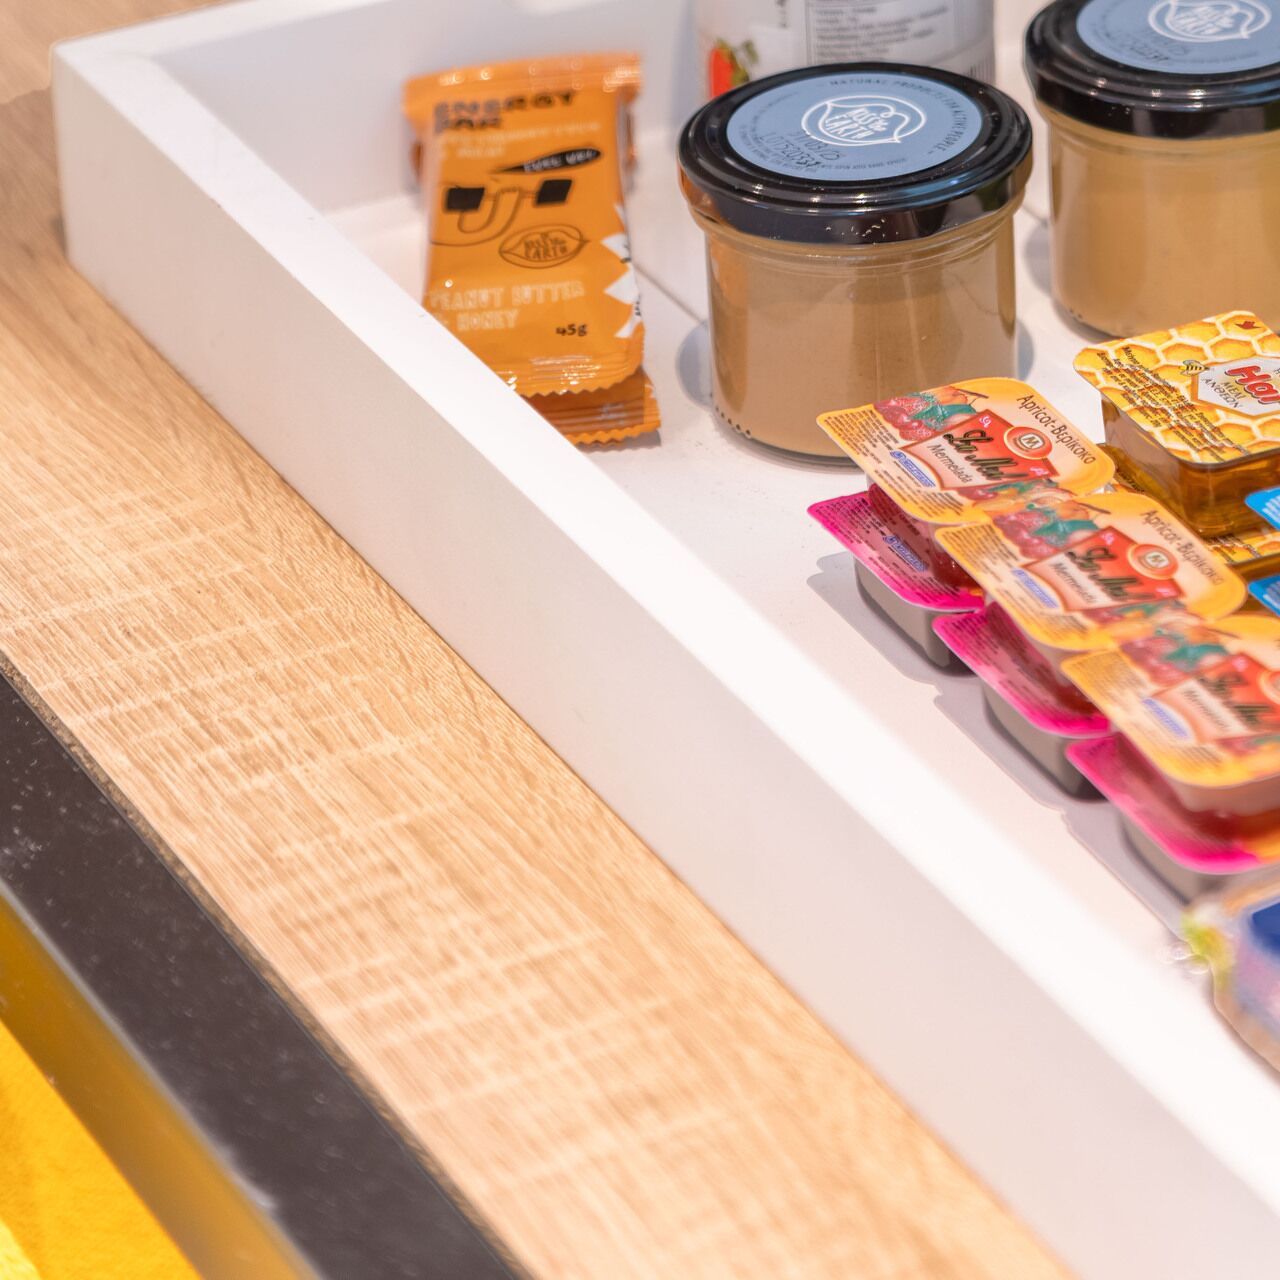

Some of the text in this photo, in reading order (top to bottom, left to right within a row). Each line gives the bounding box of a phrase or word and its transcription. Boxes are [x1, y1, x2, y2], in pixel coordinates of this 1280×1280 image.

[429, 280, 584, 311] PEANUT BUTTER
[457, 308, 519, 332] HONEY
[555, 323, 588, 337] 45g
[926, 444, 973, 483] Mermelada
